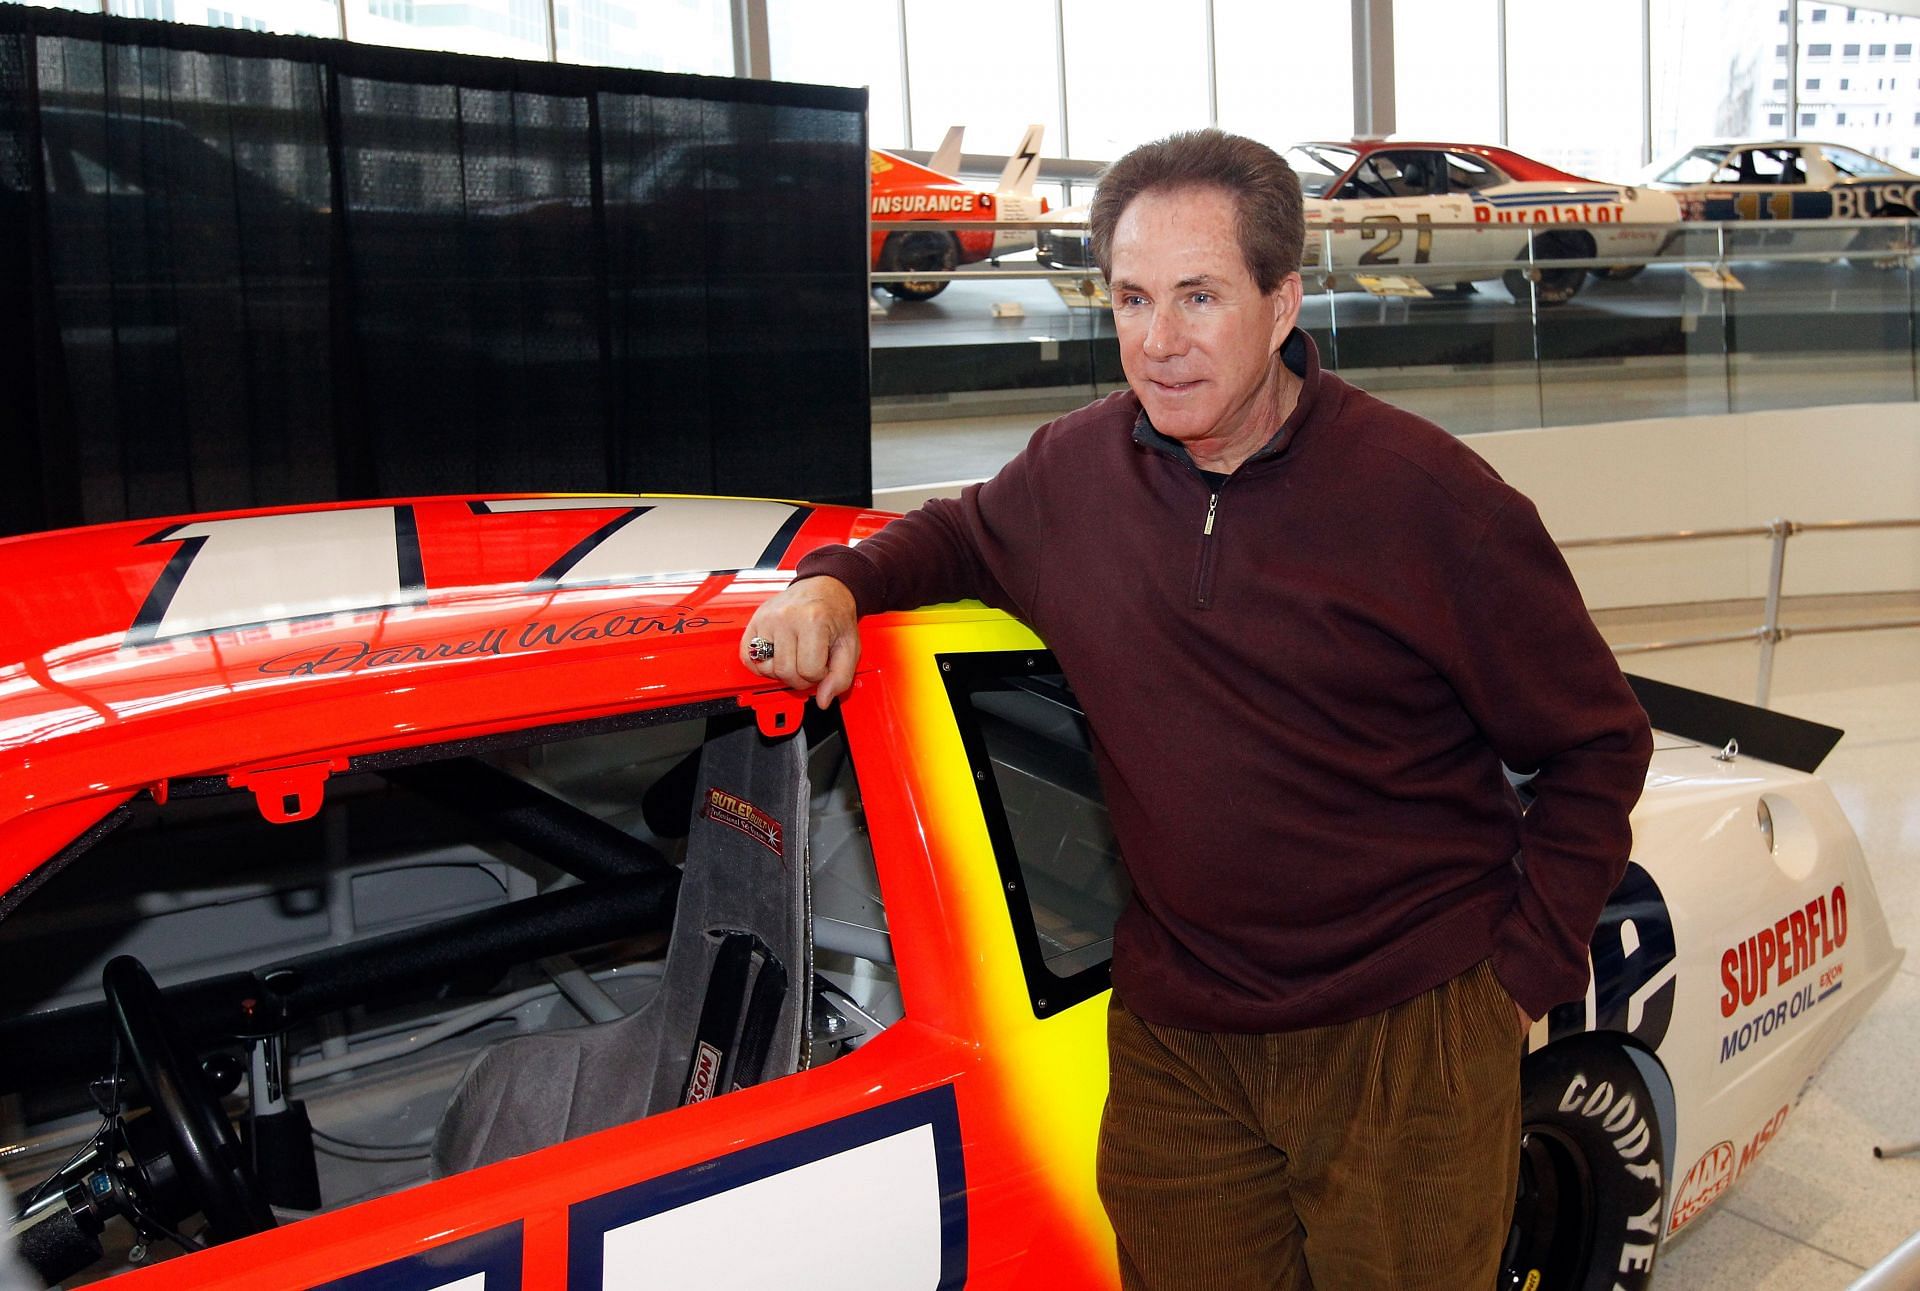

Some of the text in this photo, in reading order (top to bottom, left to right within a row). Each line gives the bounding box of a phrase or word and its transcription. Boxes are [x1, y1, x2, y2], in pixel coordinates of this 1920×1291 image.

[872, 194, 974, 214] INSURANCE
[1358, 213, 1433, 266] 21
[122, 499, 816, 649] 17
[258, 604, 736, 680] Darrell Waltrip
[1720, 885, 1848, 1019] SUPERFLO
[1719, 983, 1816, 1064] MOTOR OIL
[1735, 1103, 1789, 1181] MSD
